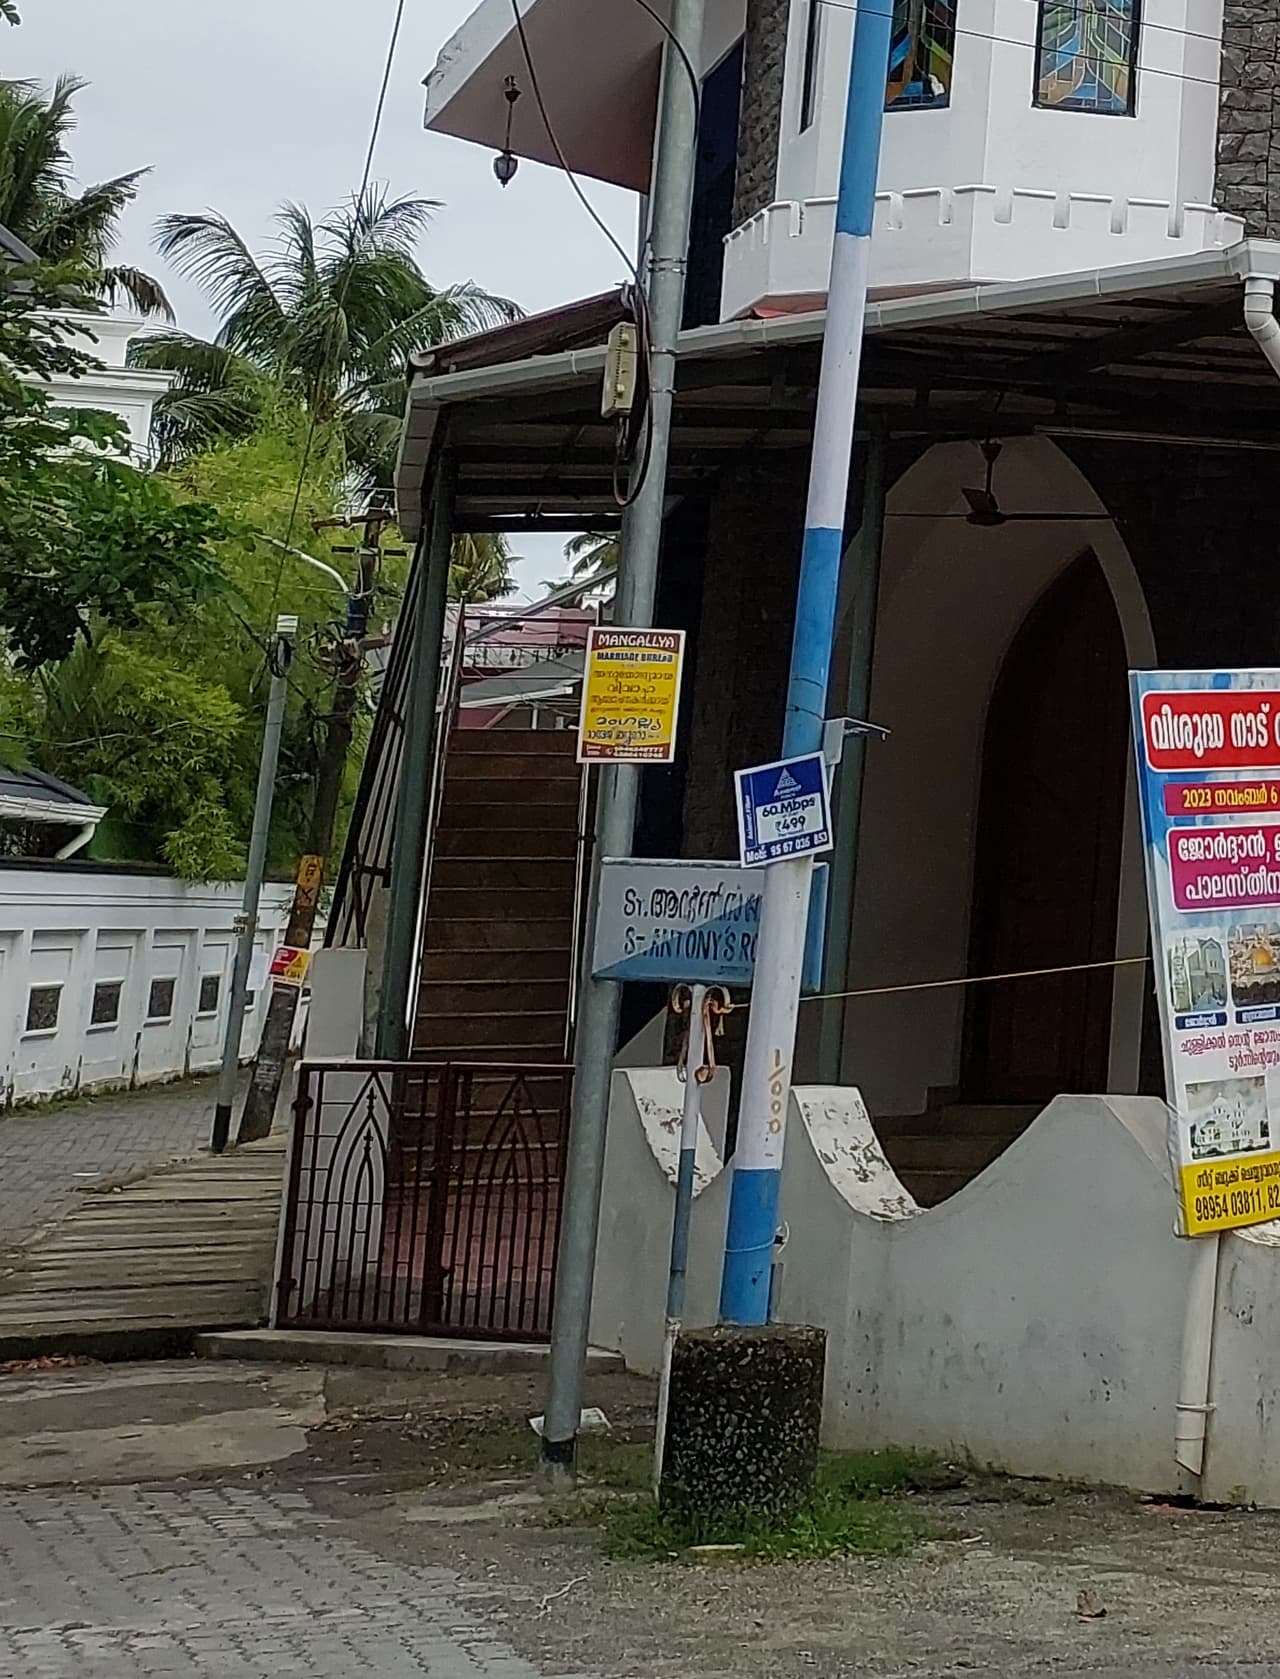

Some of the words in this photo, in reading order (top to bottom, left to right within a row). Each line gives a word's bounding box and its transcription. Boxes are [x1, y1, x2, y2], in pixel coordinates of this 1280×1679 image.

[598, 634, 675, 648] MANGALLYA
[1150, 704, 1225, 758] വിശുദ്ധ
[1231, 703, 1271, 748] നാട്
[1183, 789, 1212, 808] 2023
[1215, 783, 1267, 807] നവംബർ
[1270, 786, 1278, 805] 6
[762, 804, 778, 818] 60
[1178, 830, 1271, 863] ജോർദ്ദാൻ,
[1195, 1191, 1228, 1222] 98954
[1230, 1187, 1267, 1218] 03811,
